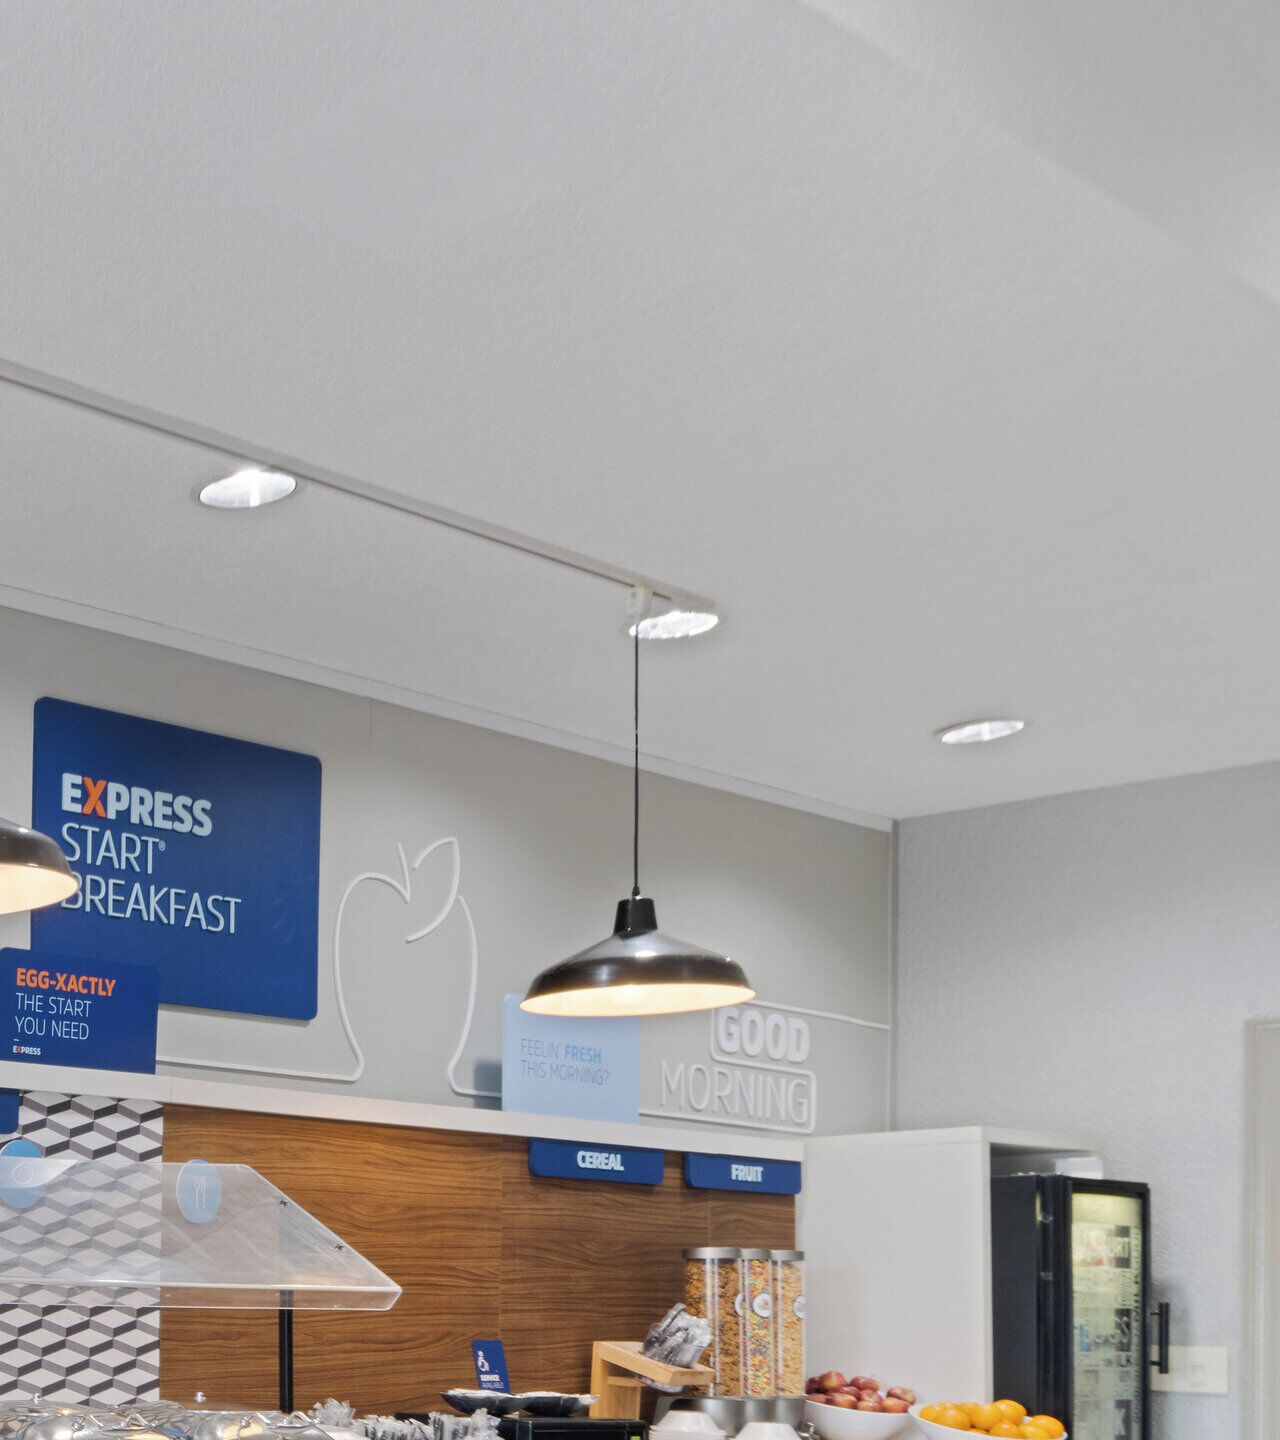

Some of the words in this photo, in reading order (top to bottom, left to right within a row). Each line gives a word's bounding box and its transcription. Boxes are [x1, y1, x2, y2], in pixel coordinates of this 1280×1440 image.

[61, 772, 213, 837] EXPRESS
[15, 967, 116, 998] EGG-XACTLY
[15, 992, 44, 1013] THE
[48, 996, 92, 1018] START
[14, 1015, 46, 1036] YOU
[51, 1019, 90, 1041] NEED
[718, 1005, 811, 1063] GOOD
[12, 1045, 42, 1056] EXPRESS
[564, 1043, 602, 1065] FRESH
[519, 1058, 546, 1080] THIS
[549, 1062, 610, 1087] MORNING?
[661, 1060, 809, 1125] MORNING
[576, 1149, 624, 1172] CEREAL
[731, 1163, 764, 1184] FRUIT
